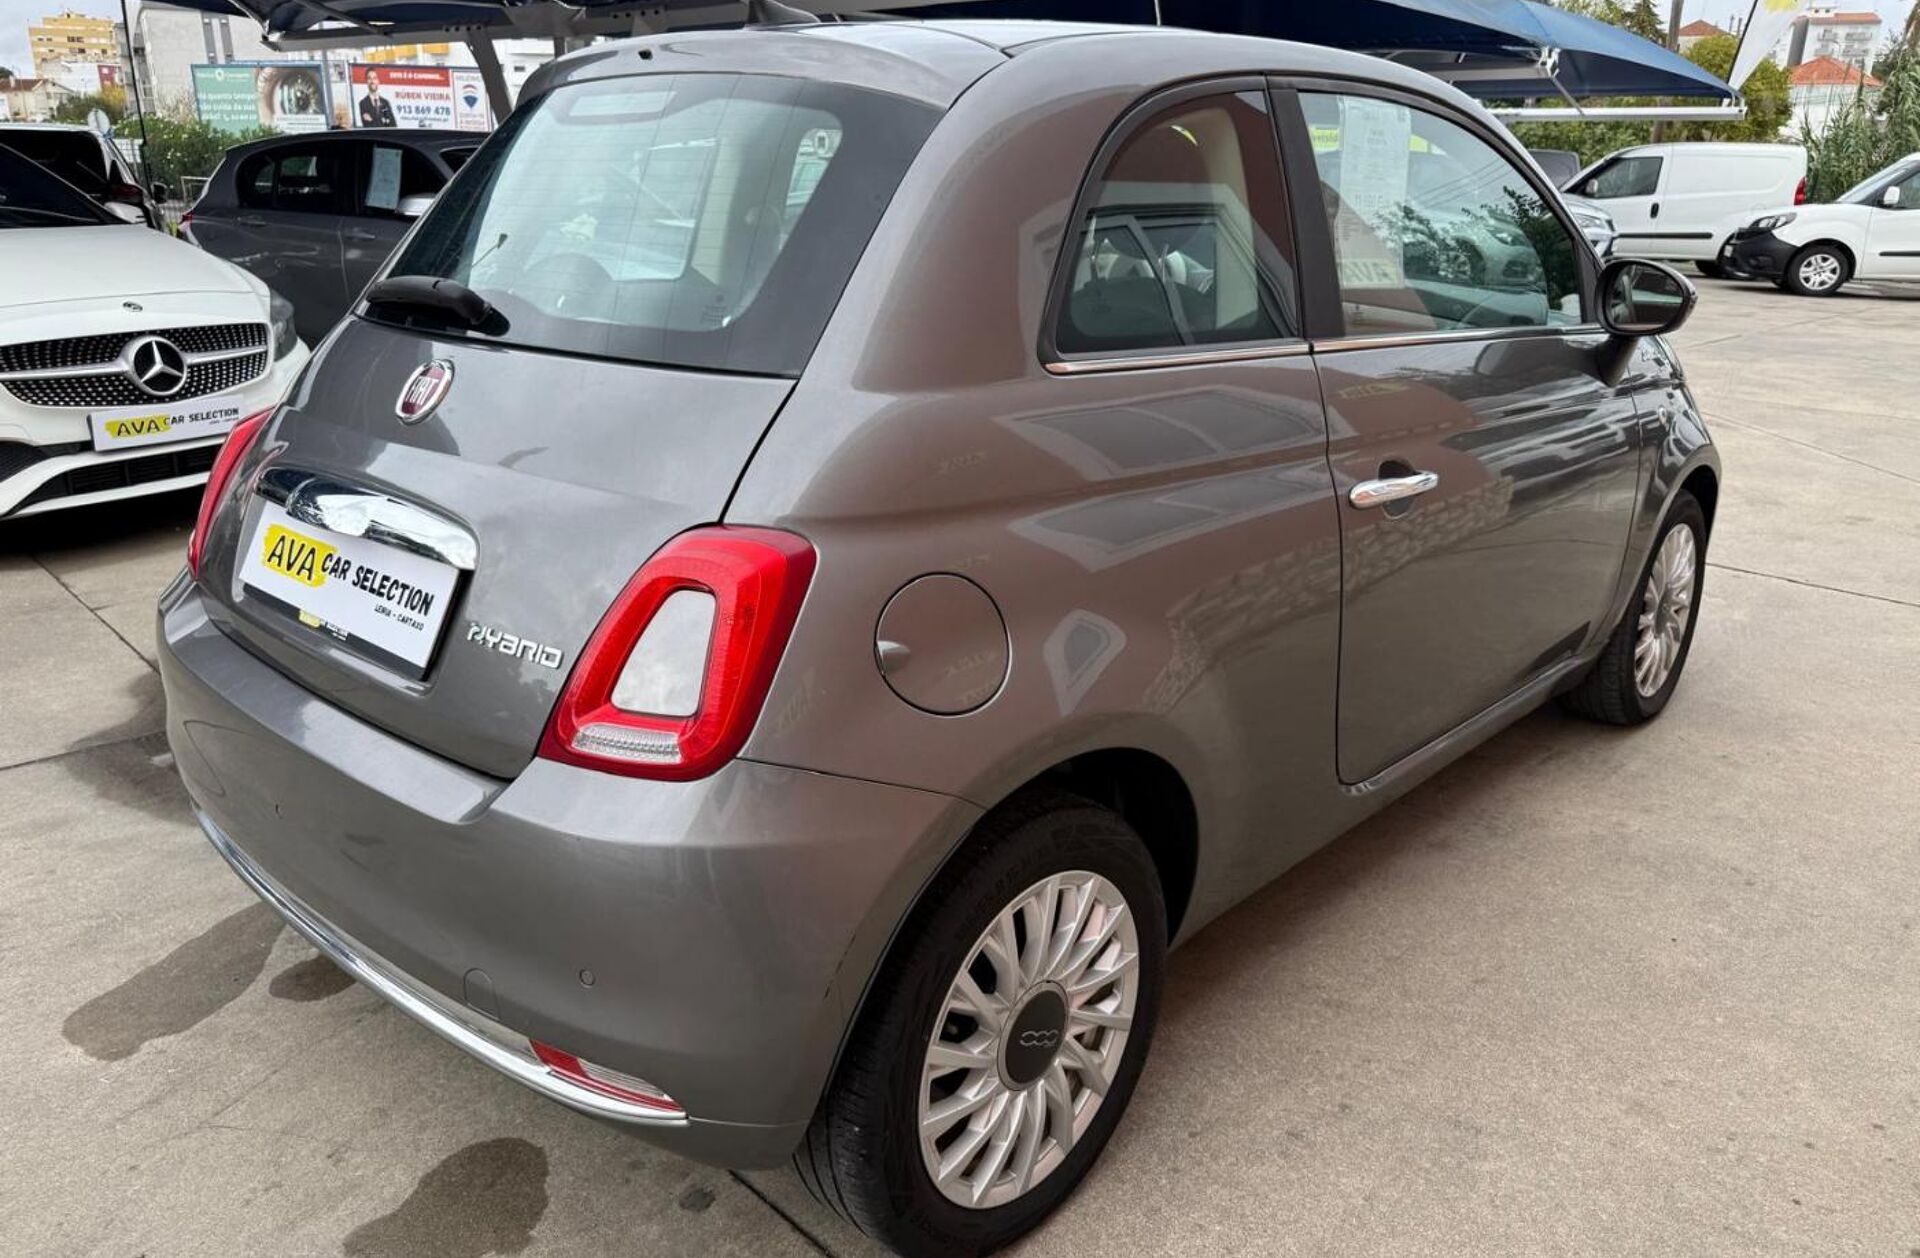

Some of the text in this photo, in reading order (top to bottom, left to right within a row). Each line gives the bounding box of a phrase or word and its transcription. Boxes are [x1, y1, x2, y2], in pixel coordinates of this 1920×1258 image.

[396, 105, 413, 114] 913
[117, 419, 160, 437] AVA
[163, 415, 185, 426] CAR
[188, 407, 240, 424] SELECTION
[267, 535, 435, 617] AVA CAR SELECTION
